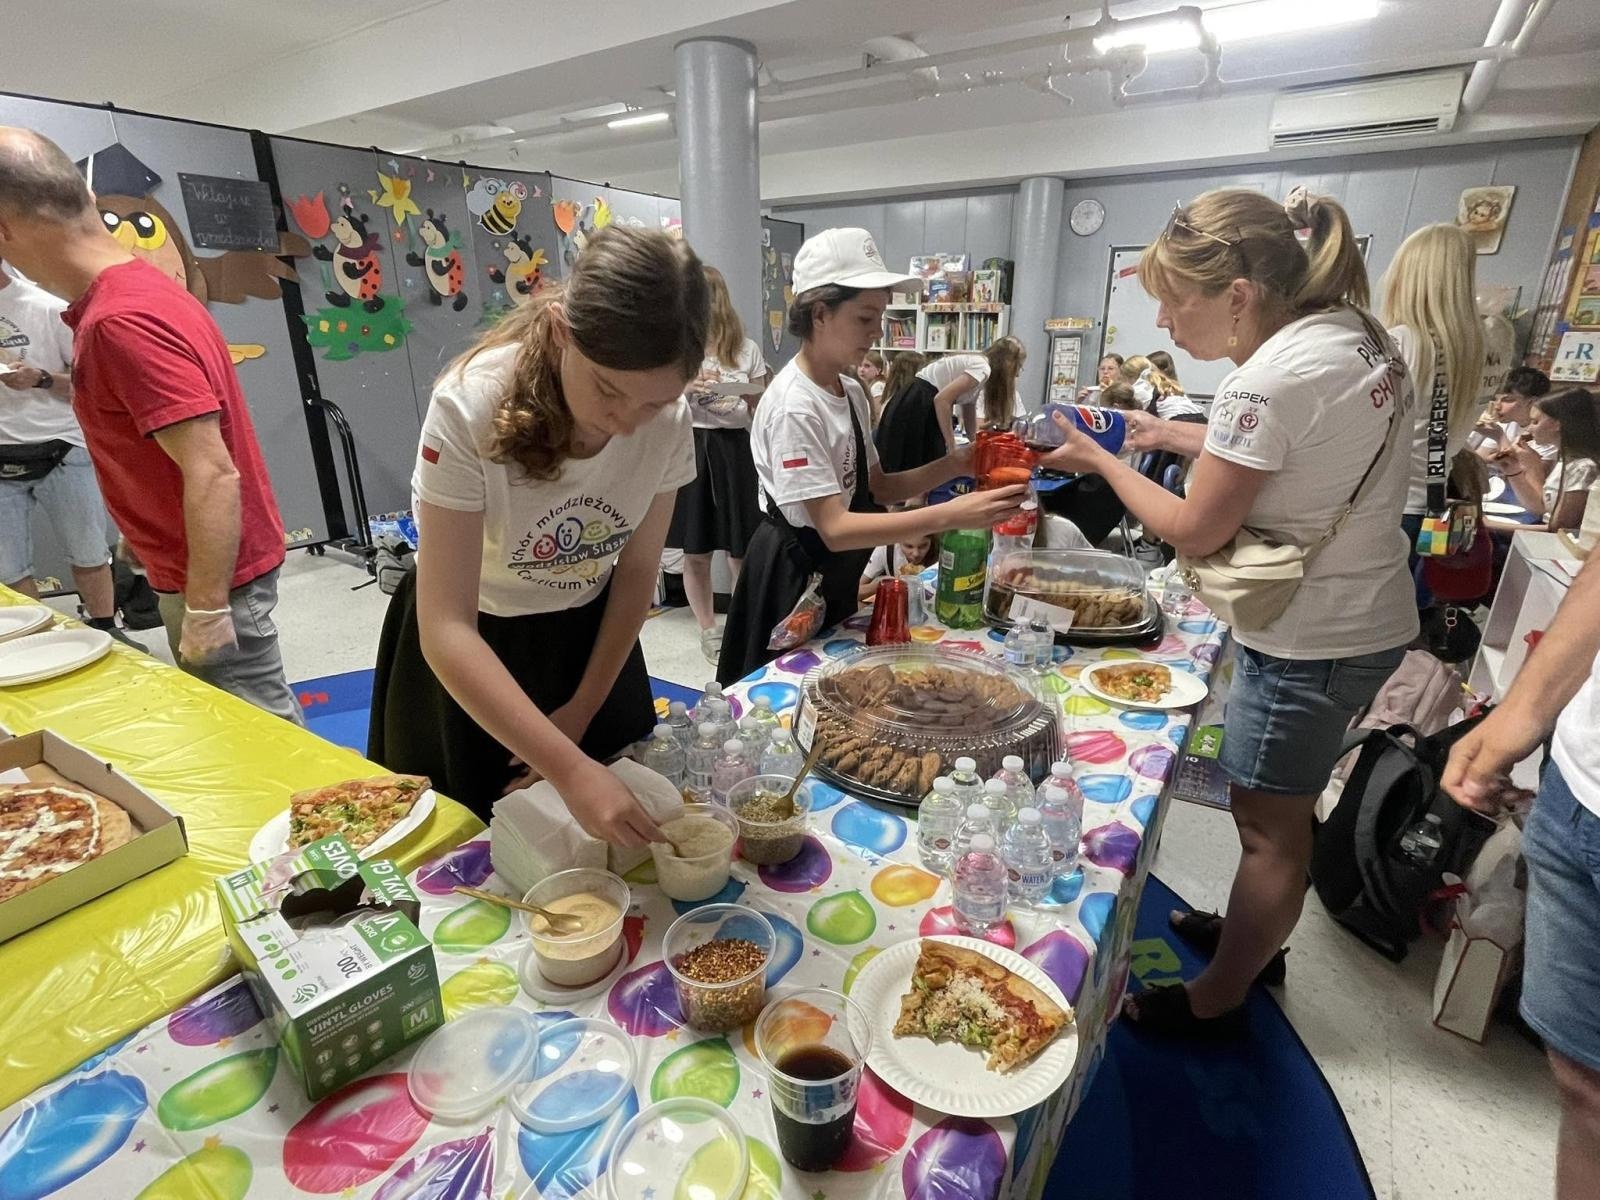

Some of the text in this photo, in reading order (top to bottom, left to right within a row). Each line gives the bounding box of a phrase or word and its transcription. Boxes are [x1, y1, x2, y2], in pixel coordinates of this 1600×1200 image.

[511, 494, 629, 562] chór młodzieżowy
[308, 1012, 349, 1036] VINYL
[348, 983, 394, 1014] GLOVES
[410, 1007, 429, 1028] M
